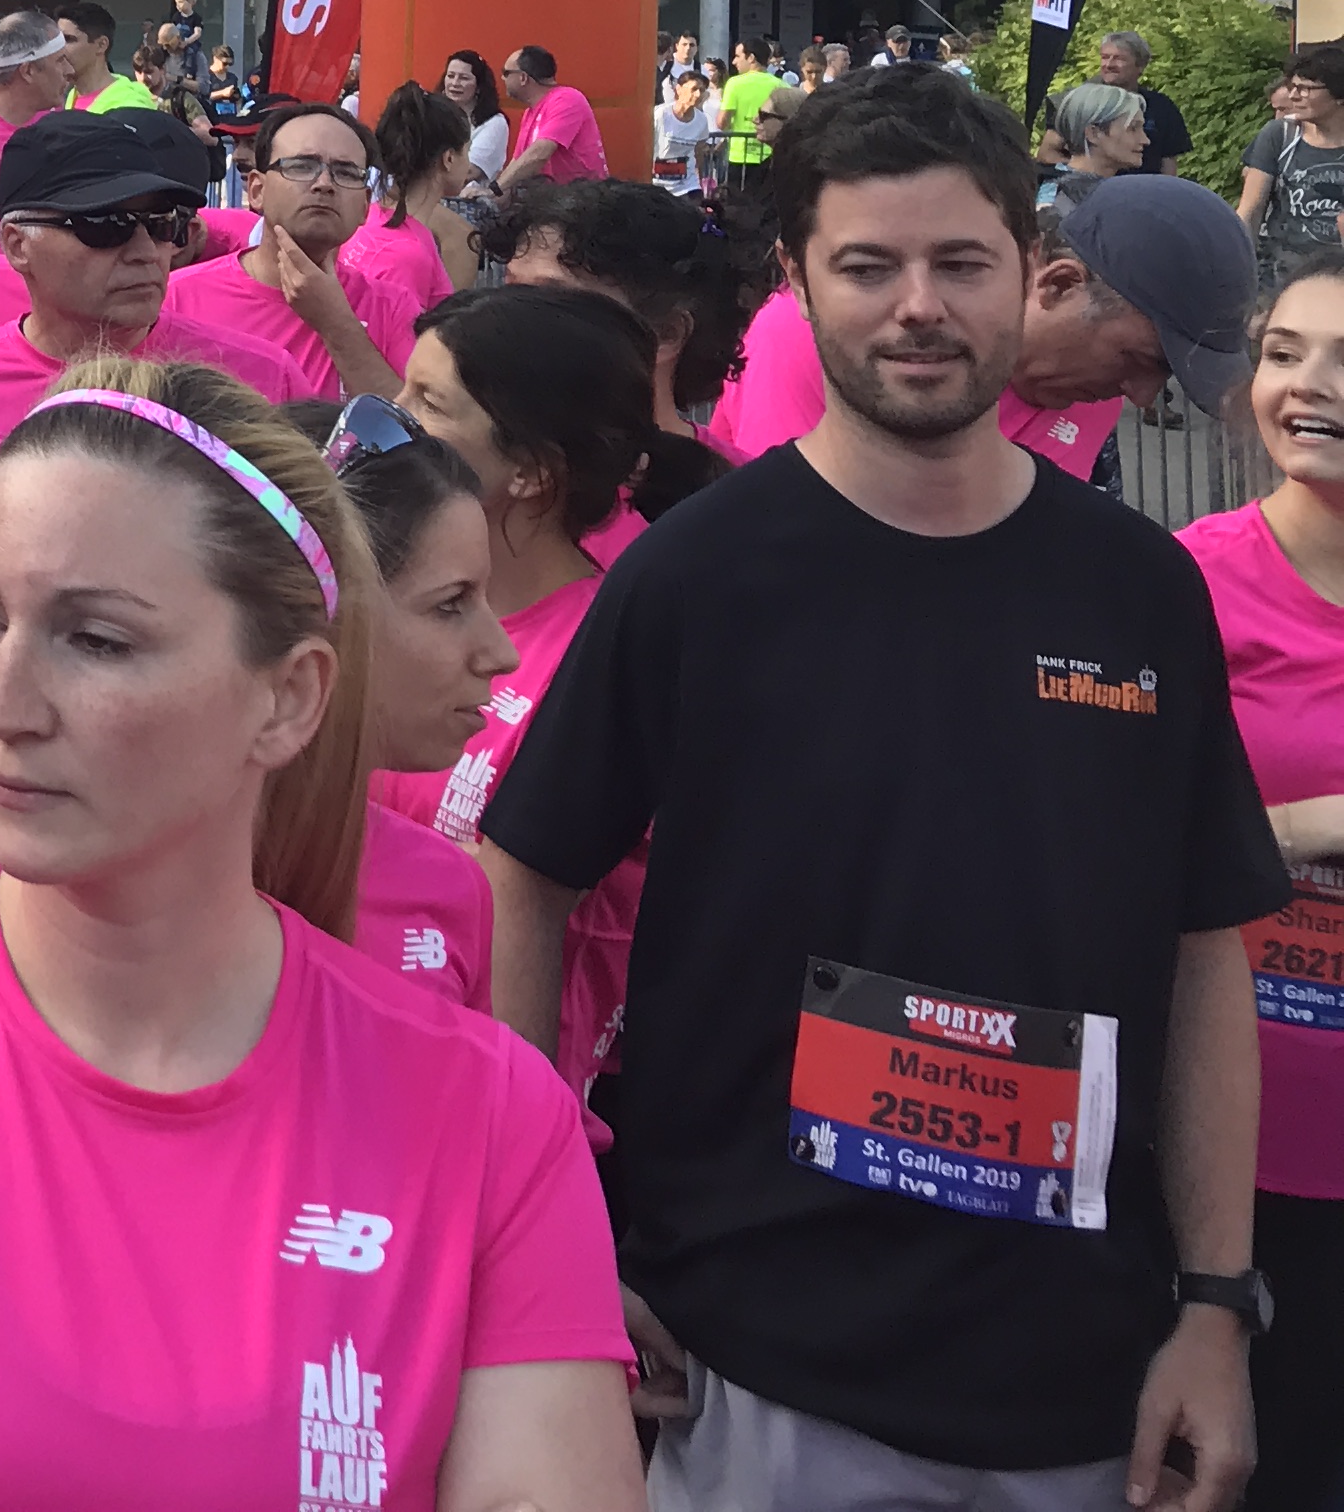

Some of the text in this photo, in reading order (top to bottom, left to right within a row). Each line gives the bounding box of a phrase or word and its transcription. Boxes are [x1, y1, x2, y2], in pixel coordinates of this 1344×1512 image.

[1036, 654, 1103, 674] BANK FRICK
[903, 994, 1017, 1048] SPORTXX
[1282, 982, 1336, 1007] Gallen
[888, 1046, 1020, 1102] Markus
[868, 1089, 1022, 1158] 2553-1
[861, 1138, 890, 1163] St.
[897, 1147, 968, 1181] Gallen
[972, 1165, 1022, 1192] 2019
[300, 1330, 383, 1429] AUF
[299, 1416, 387, 1461] FAHRTS
[299, 1448, 389, 1508] LAUF
